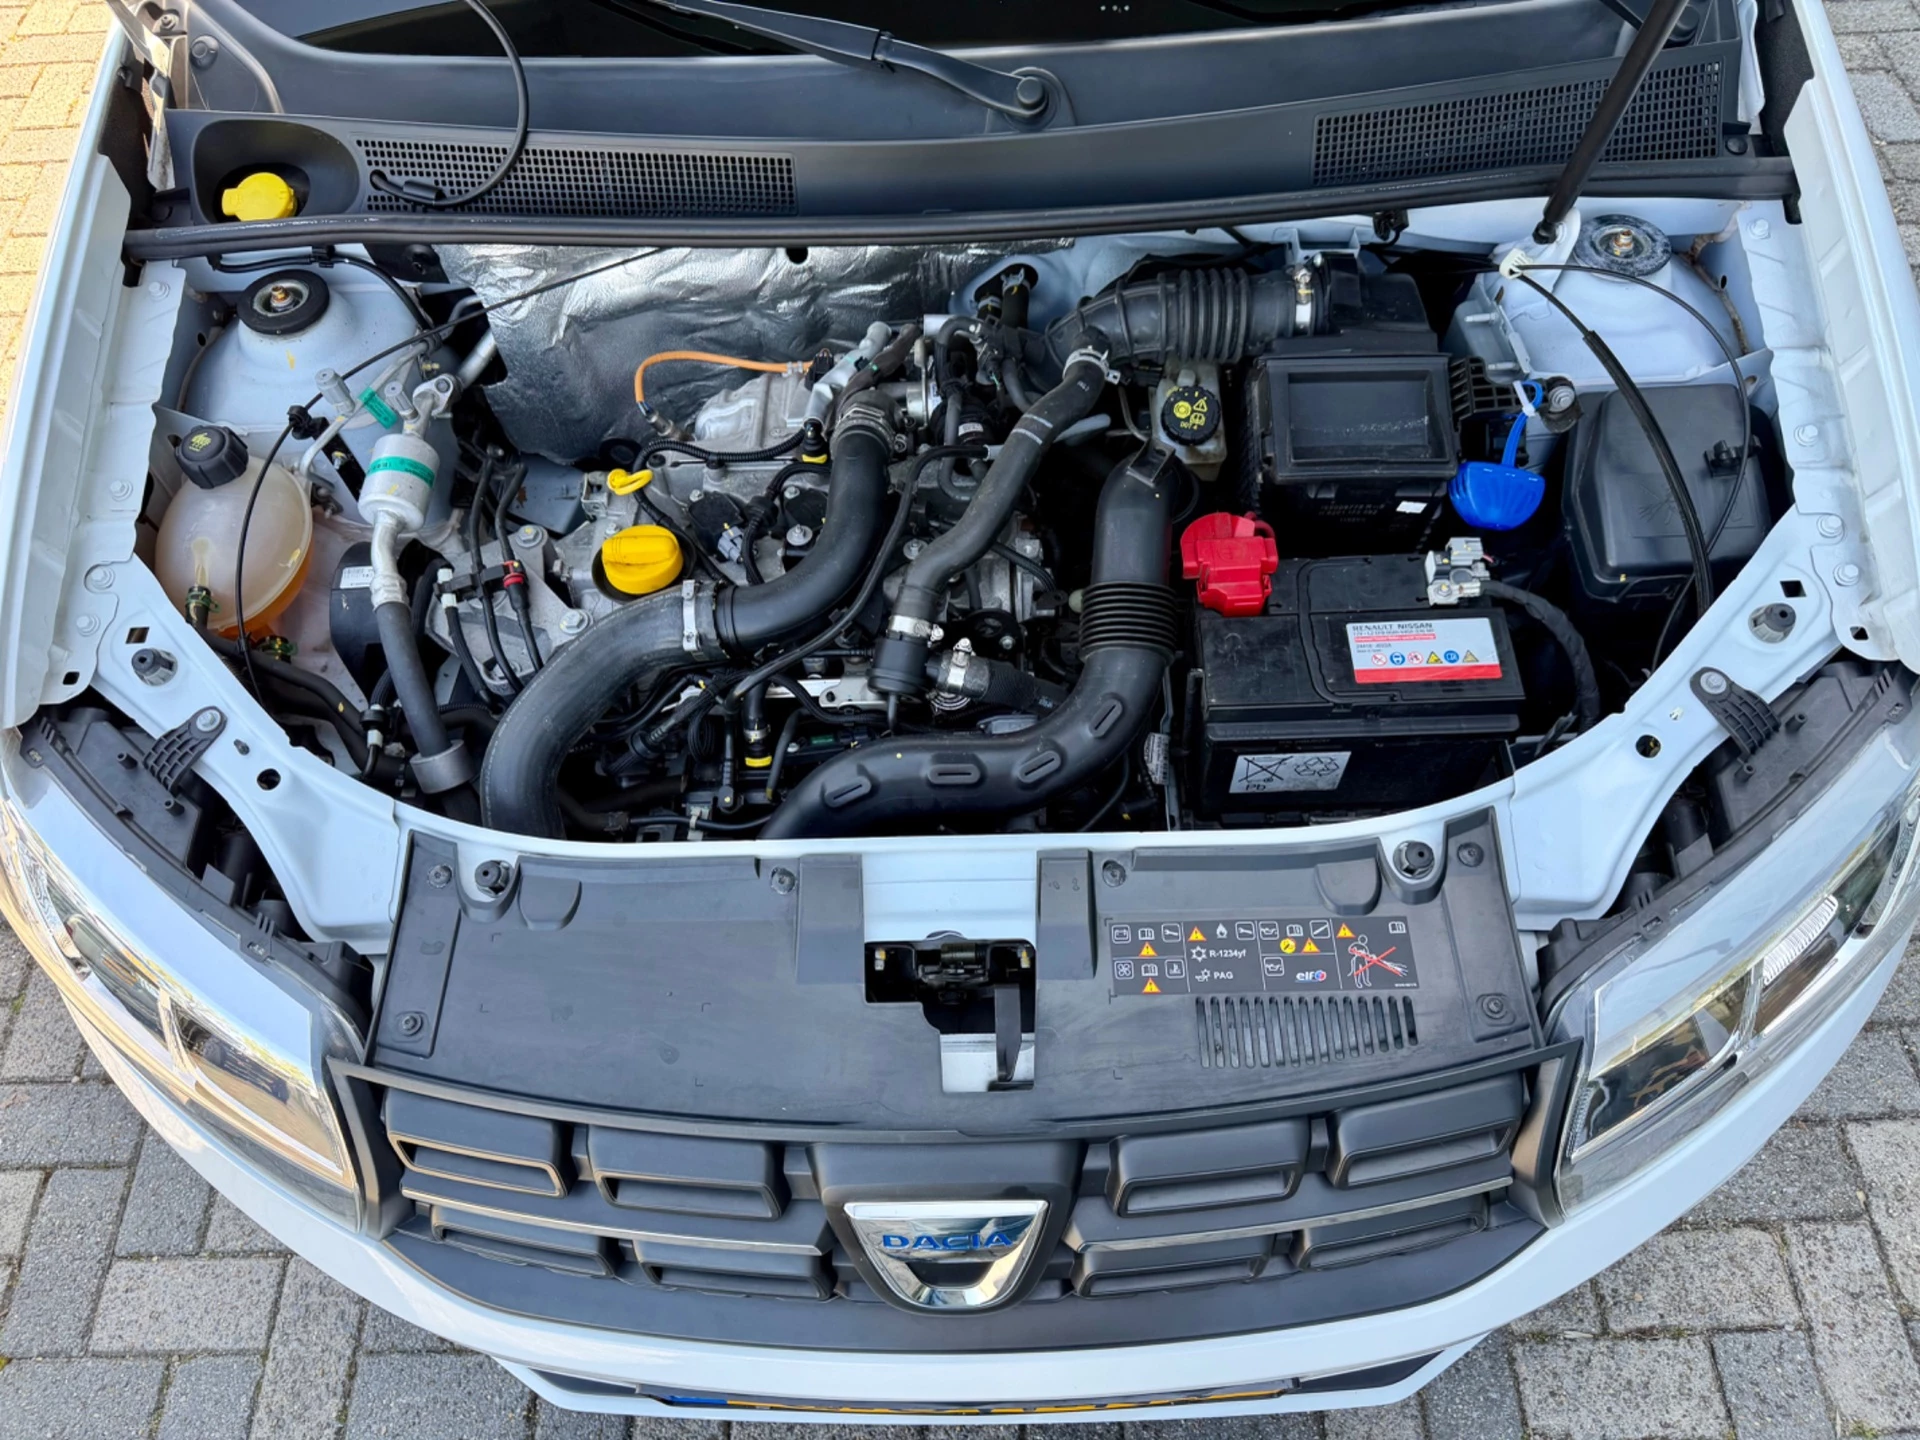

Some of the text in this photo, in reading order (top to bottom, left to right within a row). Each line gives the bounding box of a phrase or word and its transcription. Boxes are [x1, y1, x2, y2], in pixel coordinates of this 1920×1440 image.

[1397, 622, 1433, 630] NISSAN
[1209, 949, 1247, 959] R-1234yf
[1213, 971, 1234, 980] PAG
[882, 1232, 1014, 1250] DACIA
